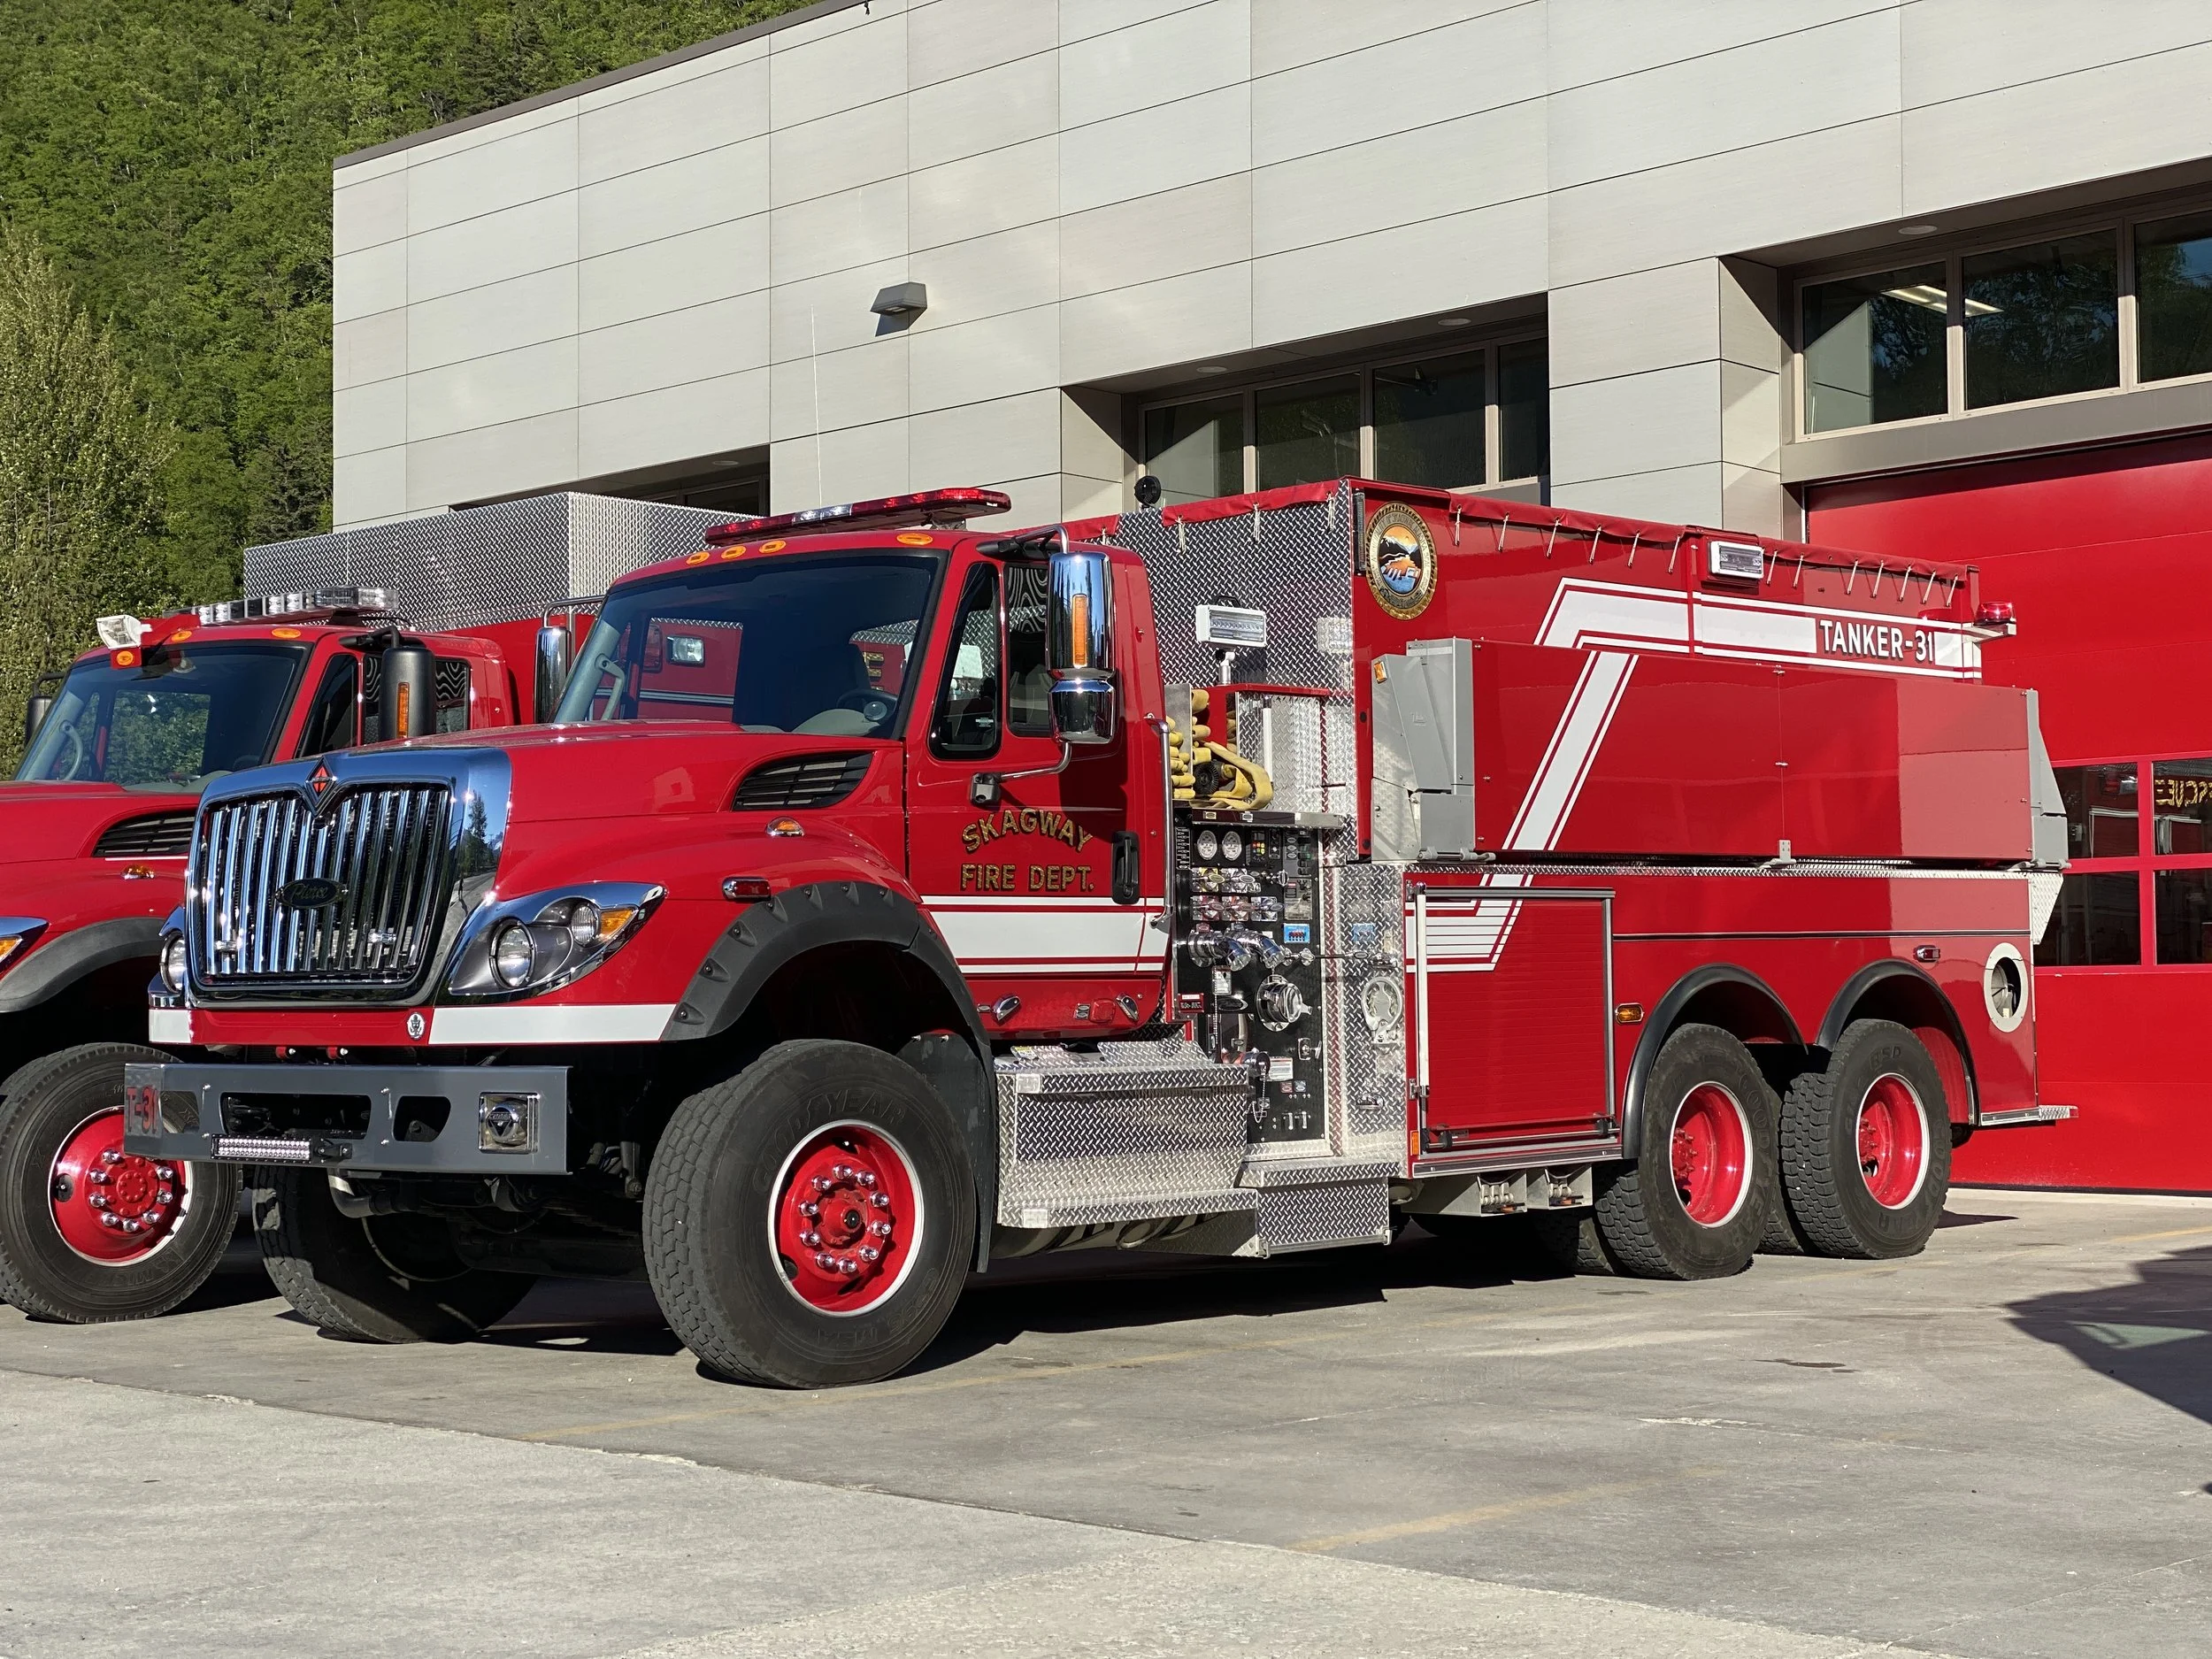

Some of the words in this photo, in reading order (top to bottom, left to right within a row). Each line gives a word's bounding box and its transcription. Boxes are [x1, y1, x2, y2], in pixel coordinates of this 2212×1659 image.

[1819, 619, 1934, 663] TANKER-31
[962, 808, 1094, 852] SKAGWAY
[961, 864, 1017, 890] FIRE
[1029, 864, 1095, 891] DEPT.
[127, 1085, 157, 1134] T-31
